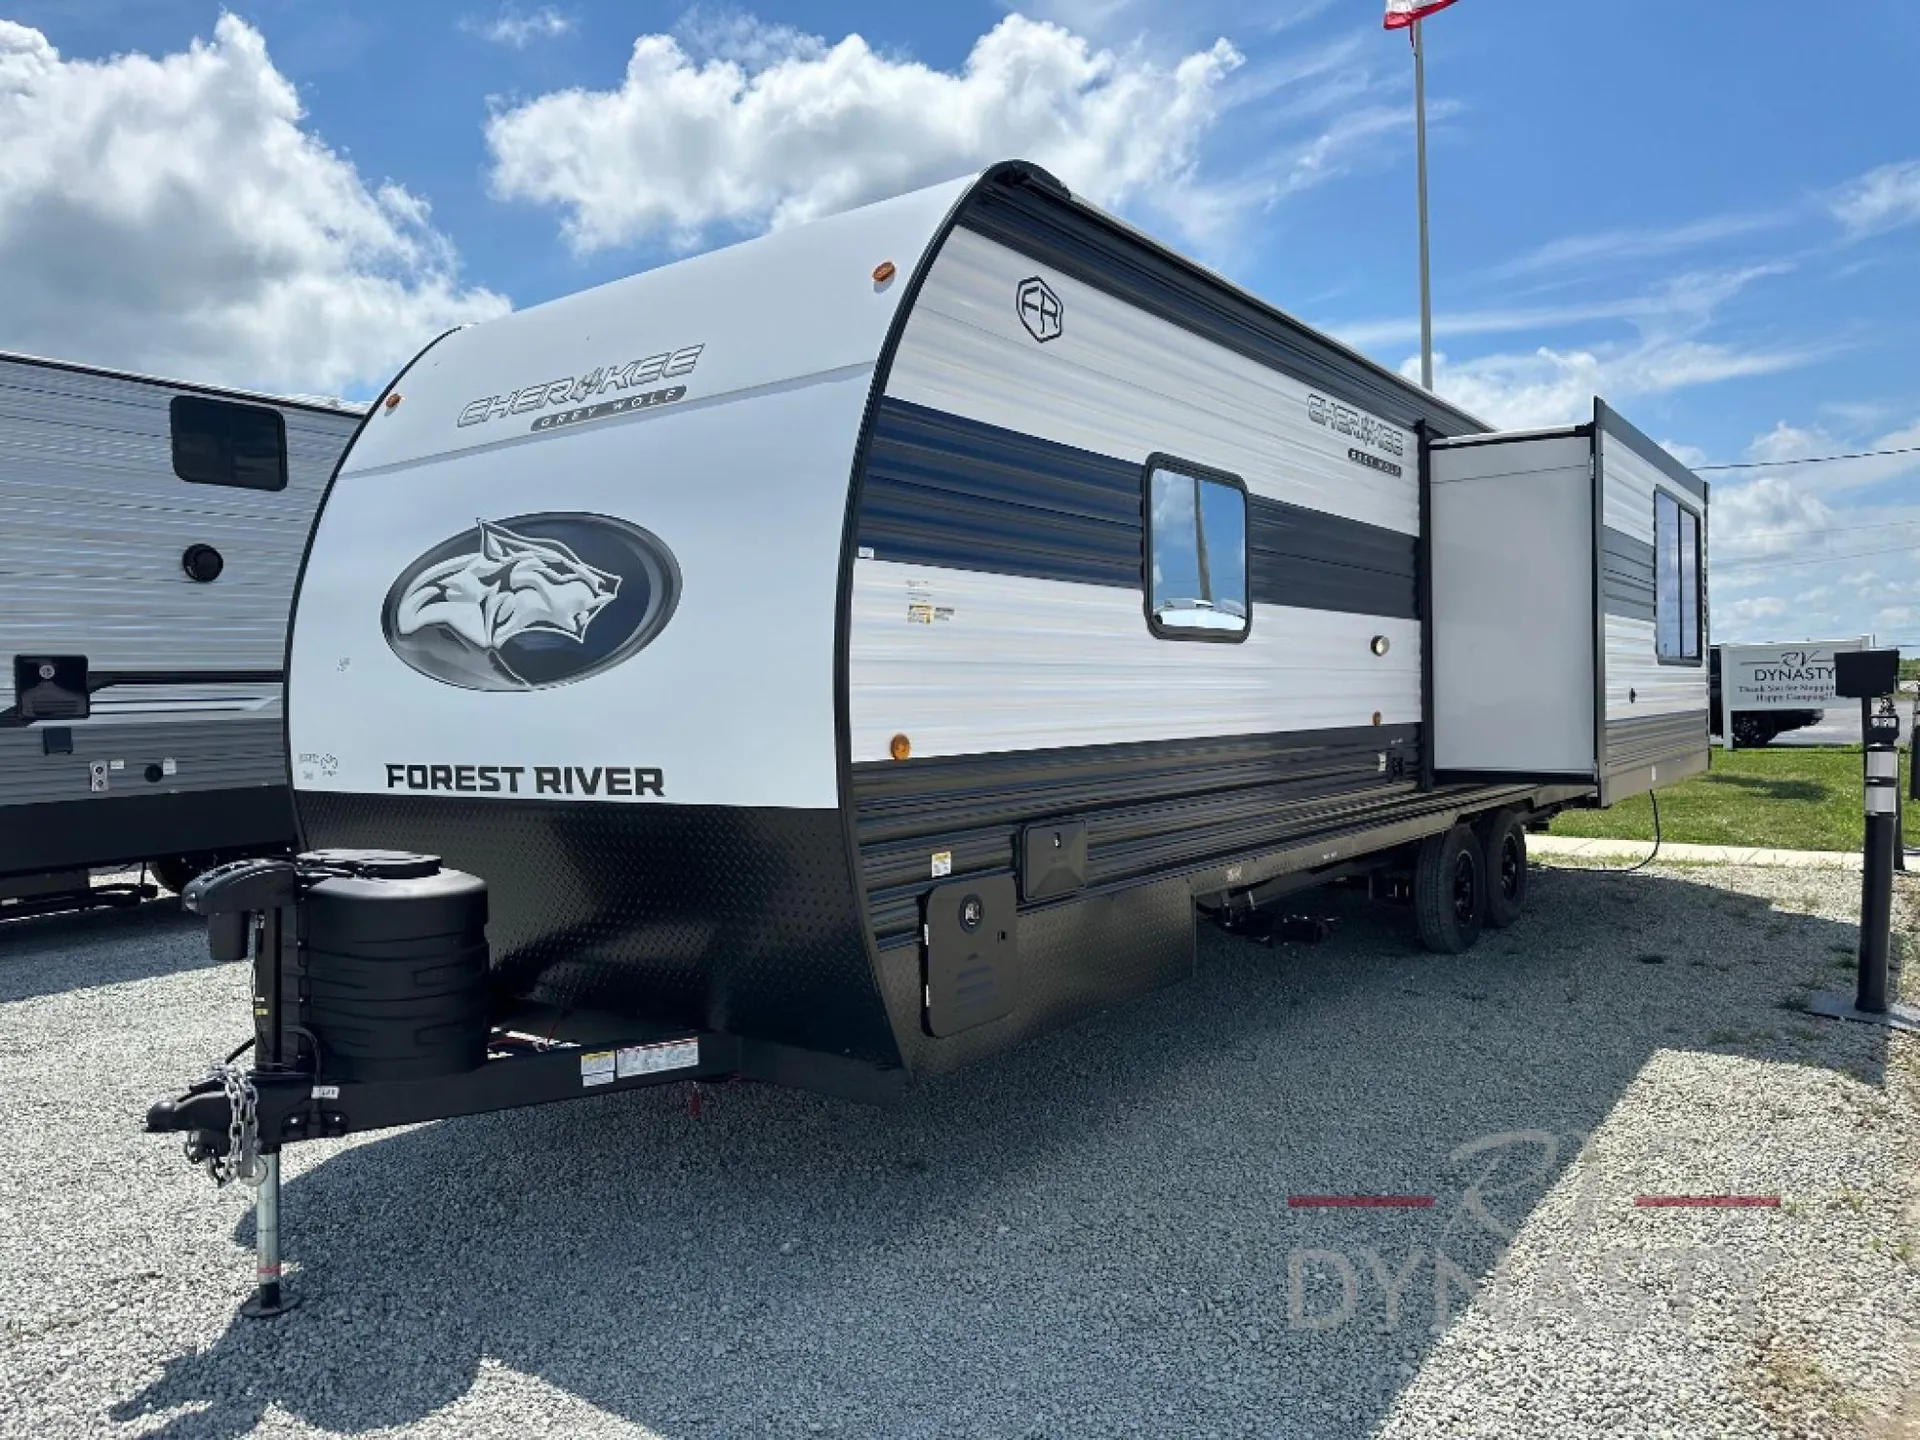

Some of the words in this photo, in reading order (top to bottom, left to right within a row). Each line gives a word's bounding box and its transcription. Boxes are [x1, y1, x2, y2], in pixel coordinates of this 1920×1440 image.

[457, 343, 705, 427] CHEROKEE
[541, 406, 598, 428] GREY
[612, 389, 677, 411] WOLF
[1754, 667, 1835, 681] DYNASTY
[384, 763, 525, 793] FOREST
[532, 766, 665, 797] RIVER
